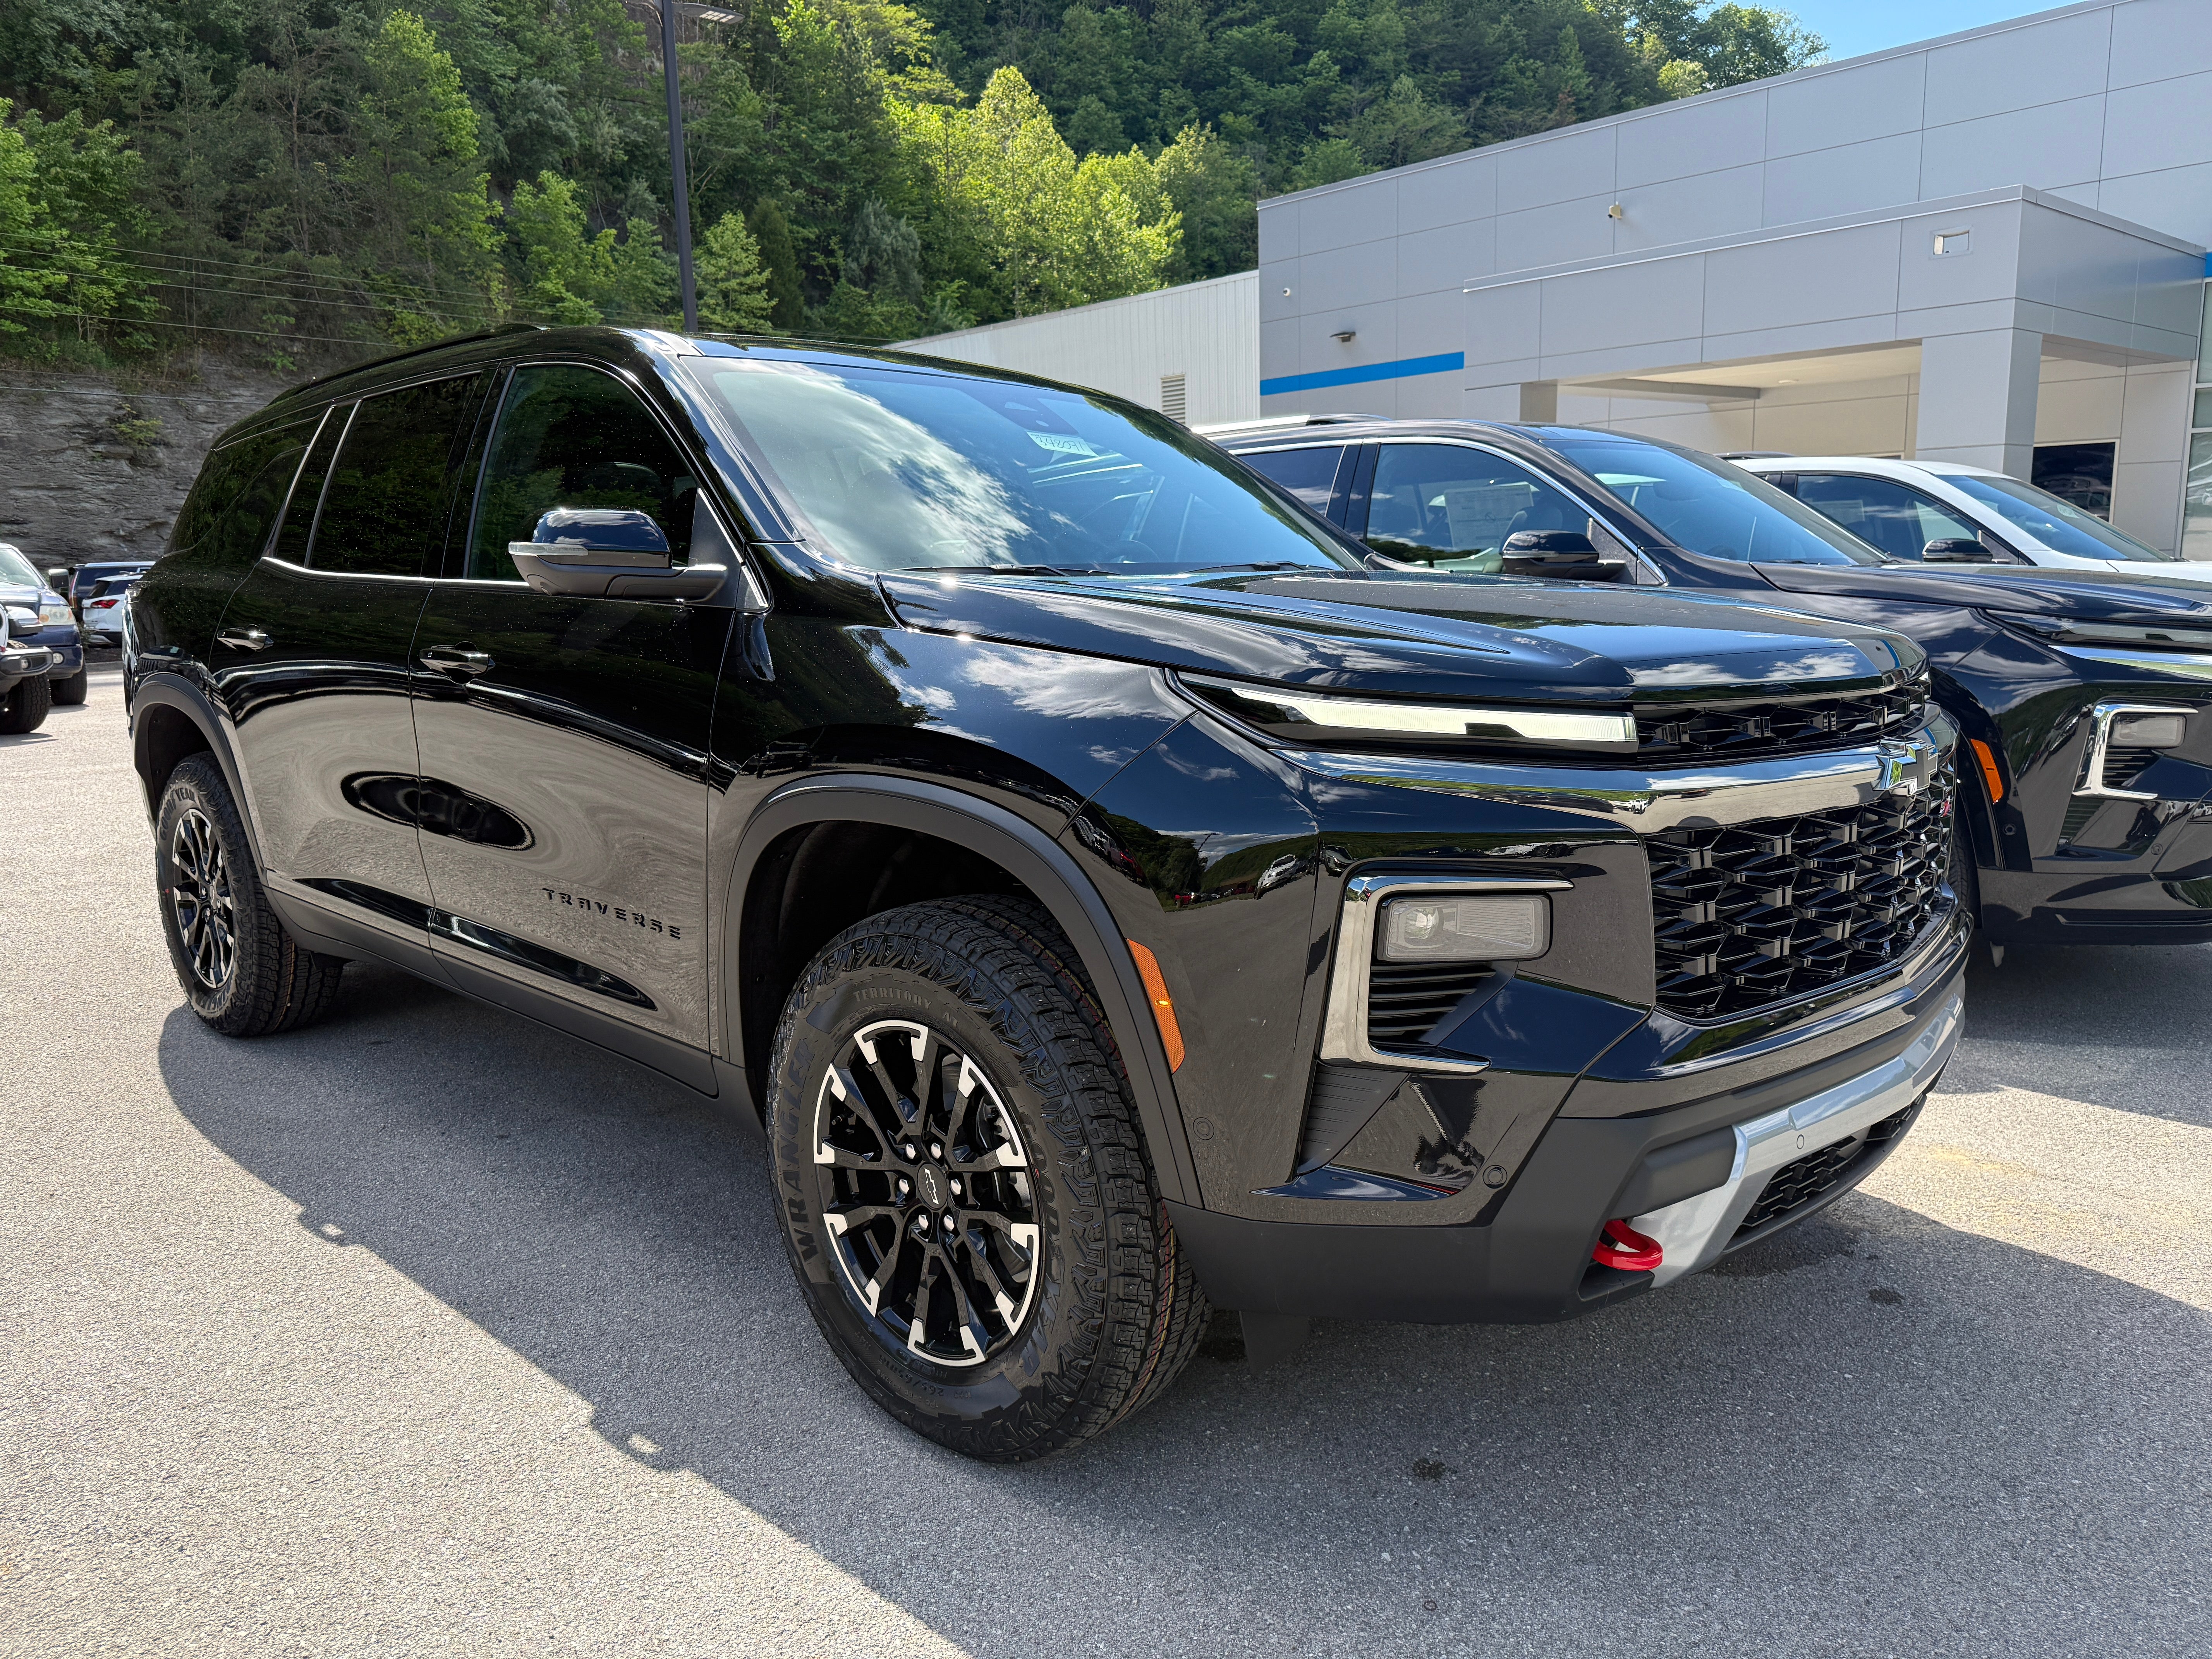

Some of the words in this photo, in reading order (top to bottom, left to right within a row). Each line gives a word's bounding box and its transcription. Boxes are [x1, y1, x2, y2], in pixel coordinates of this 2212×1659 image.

[1036, 435, 1084, 452] 348091
[541, 888, 681, 940] TRAVERSE
[853, 987, 932, 1010] TERRITORY
[943, 1012, 959, 1028] AT
[780, 1039, 818, 1262] WRANGLER
